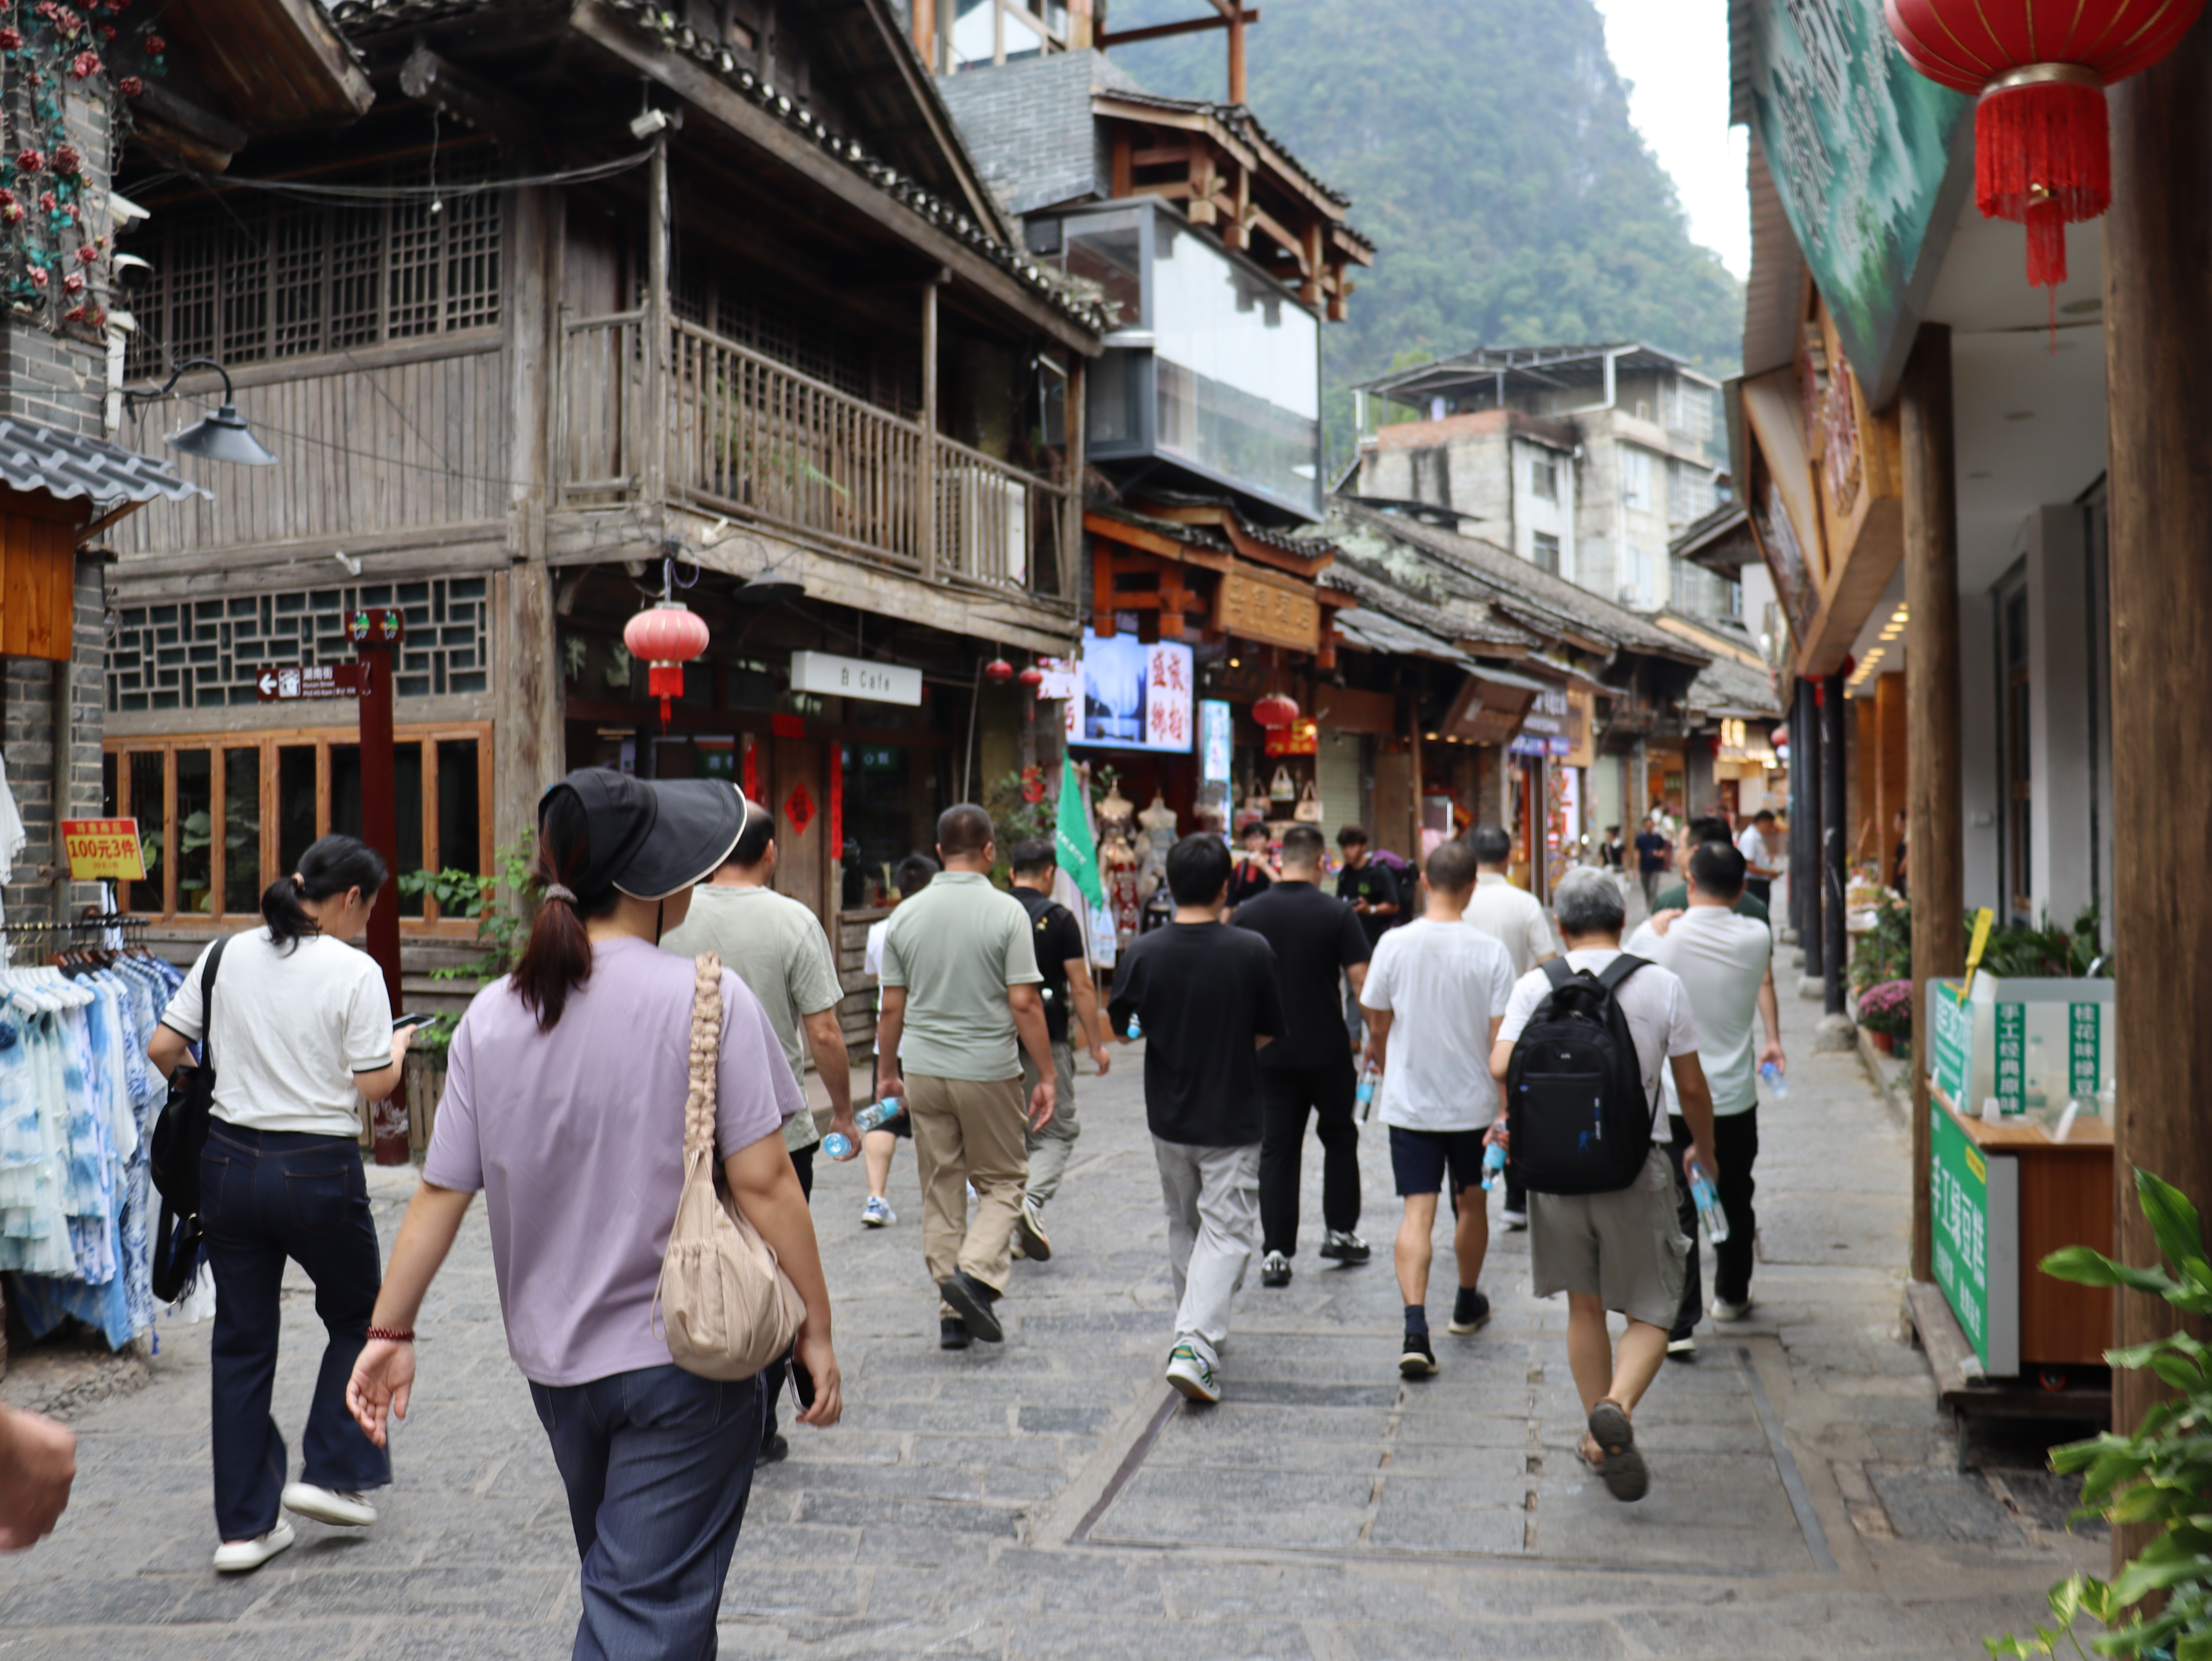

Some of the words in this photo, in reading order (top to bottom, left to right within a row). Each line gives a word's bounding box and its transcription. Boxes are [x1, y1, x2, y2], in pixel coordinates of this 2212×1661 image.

[860, 669, 890, 691] Cafe
[69, 840, 135, 860] 100元3件
[2000, 1004, 2020, 1114] 手工经典原味
[2075, 1004, 2095, 1113] 桂花味绿豆
